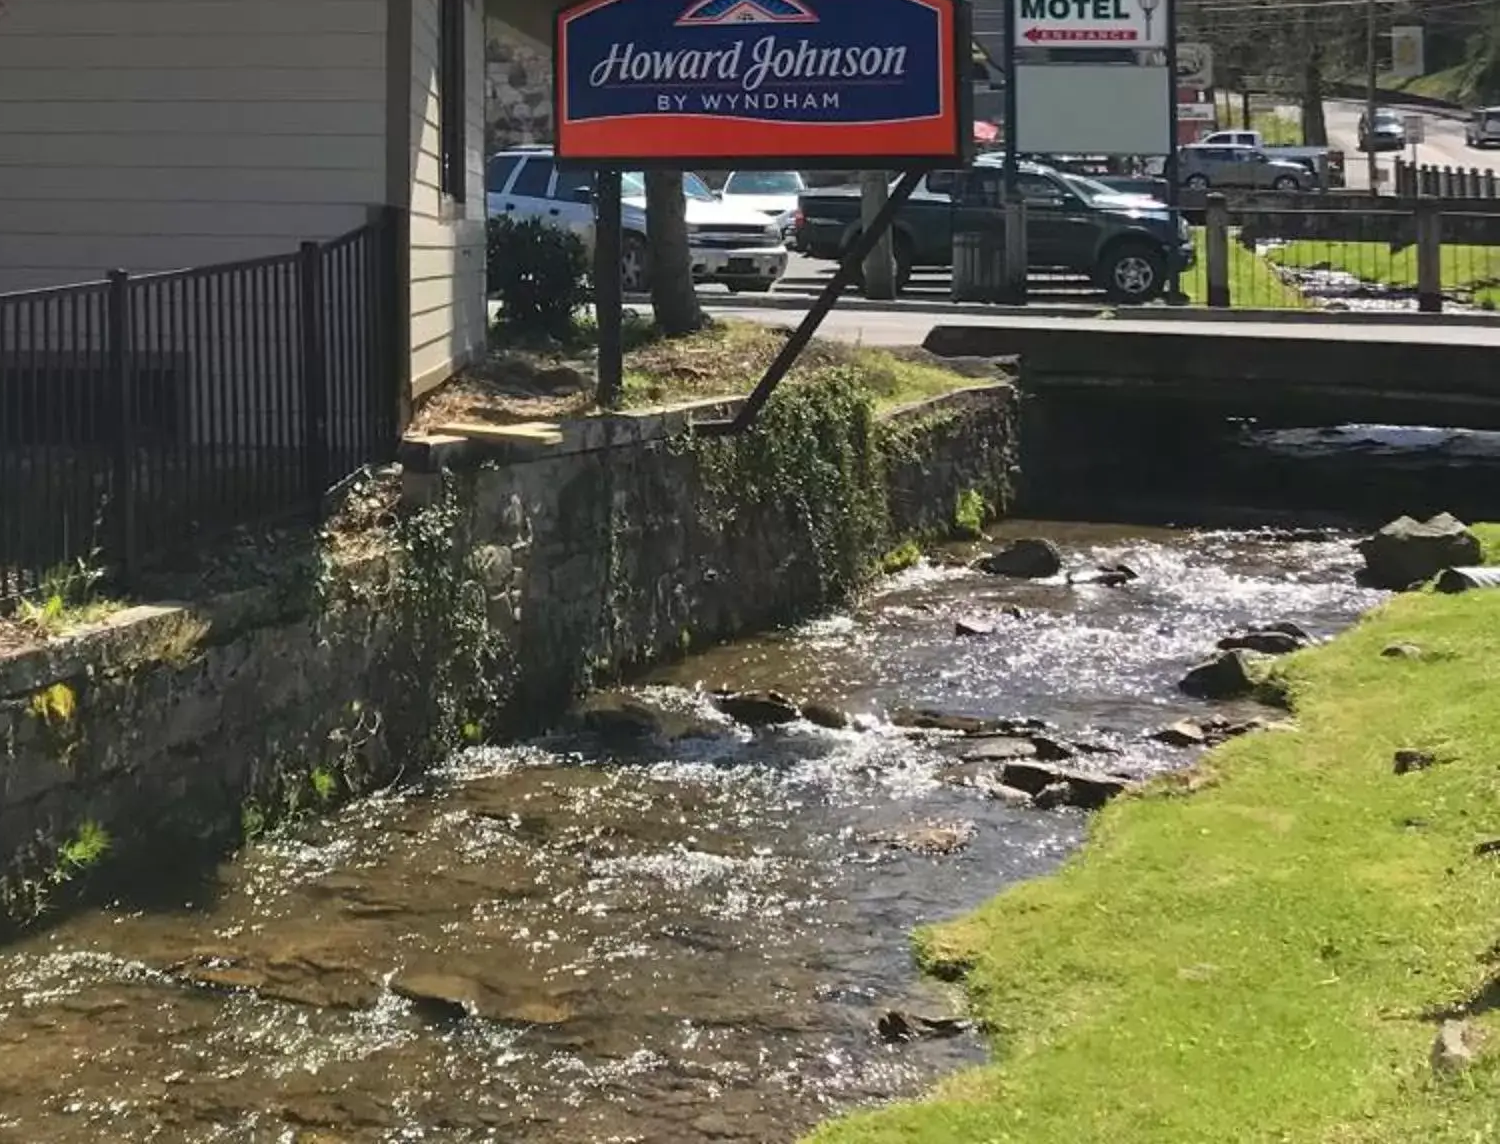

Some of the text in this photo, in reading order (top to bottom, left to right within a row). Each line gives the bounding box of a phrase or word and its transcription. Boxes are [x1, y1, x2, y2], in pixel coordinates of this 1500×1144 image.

[1041, 30, 1132, 40] ENTRANCE
[590, 35, 907, 91] Howard Johnson
[657, 92, 840, 111] BY WYNDHAM
